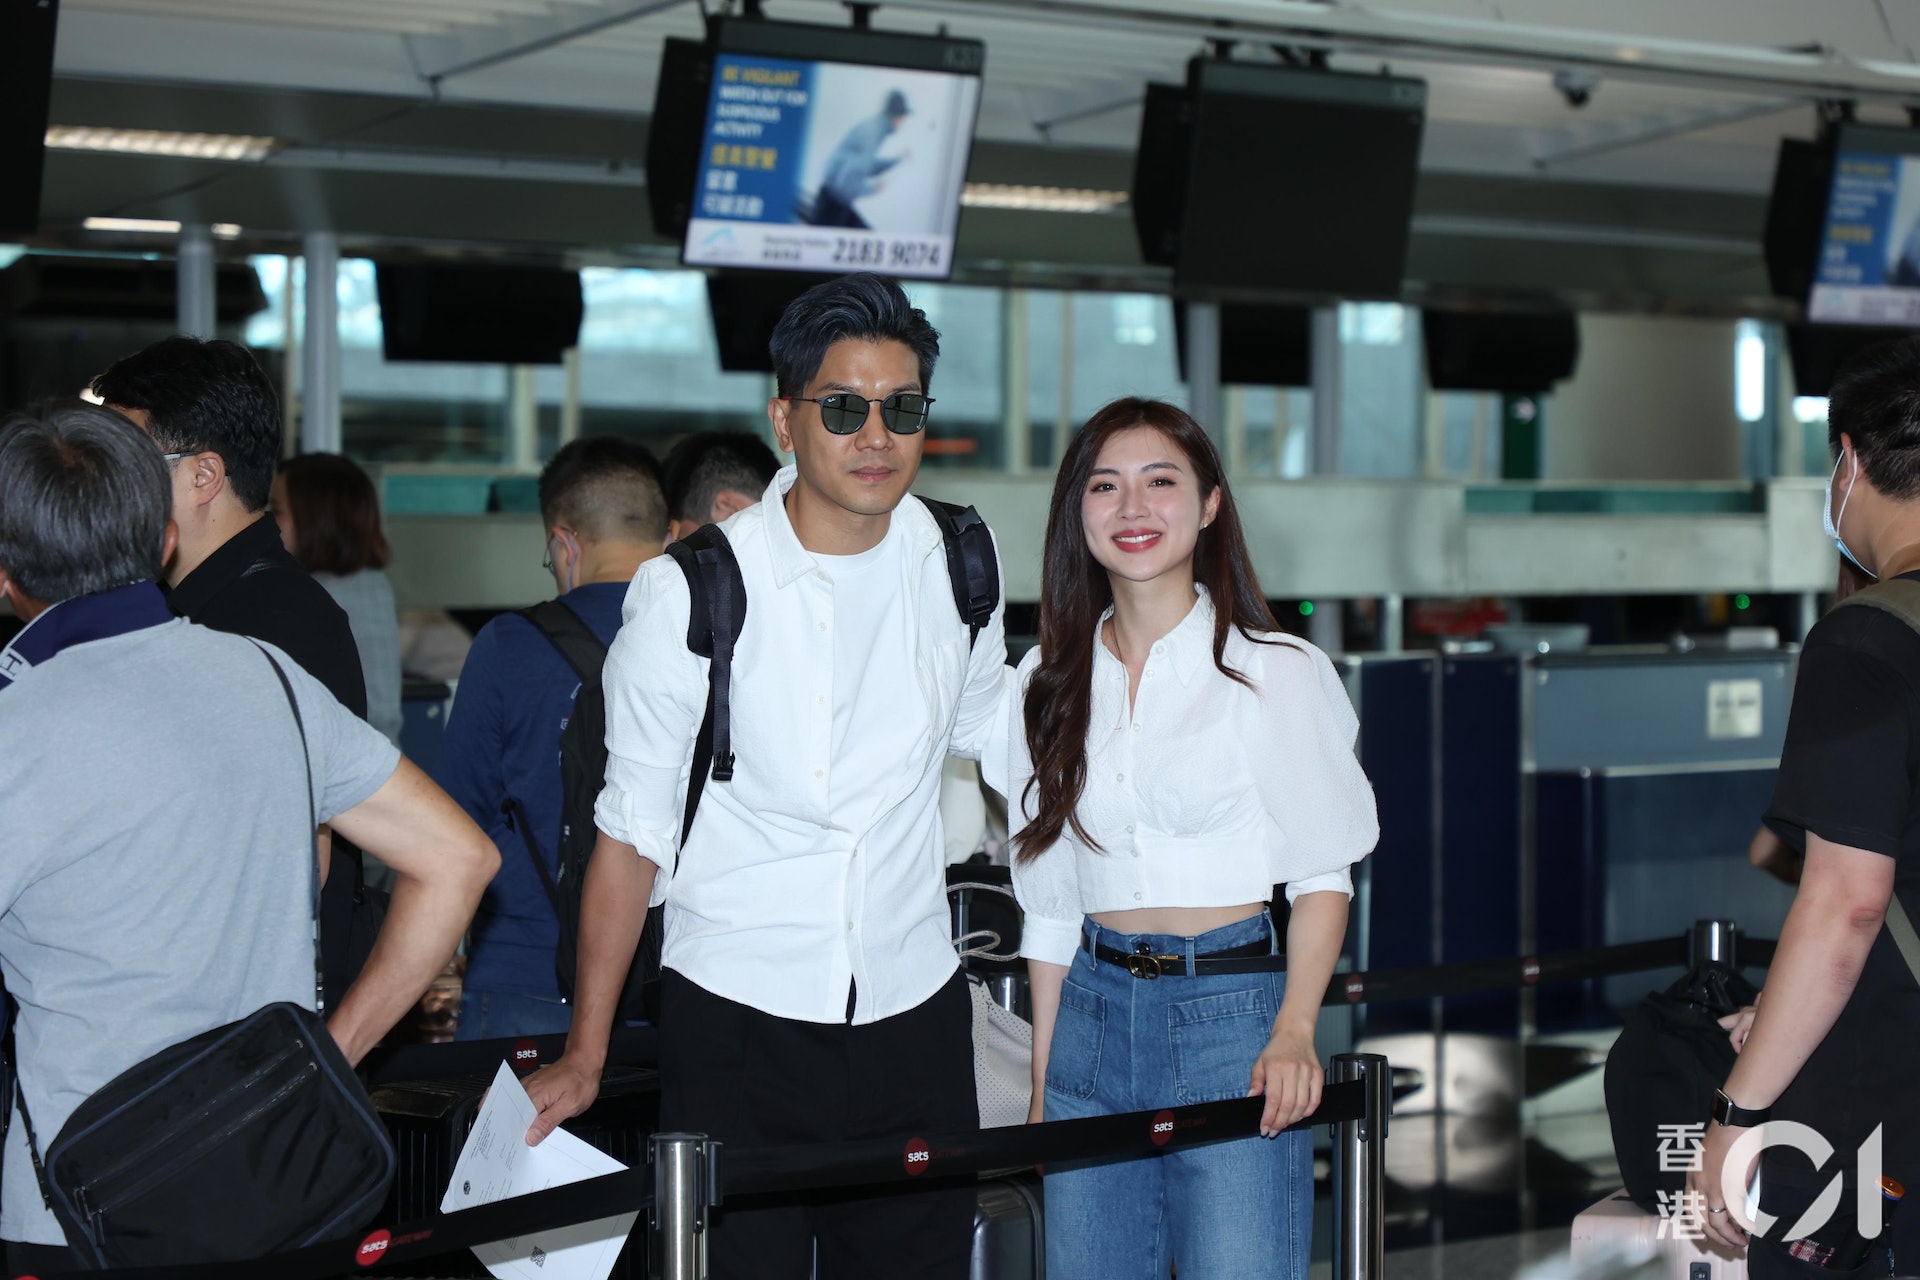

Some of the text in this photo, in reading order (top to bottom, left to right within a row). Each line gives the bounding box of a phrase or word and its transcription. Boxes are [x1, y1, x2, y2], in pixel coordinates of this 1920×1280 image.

[516, 1049, 538, 1059] sats
[1153, 1120, 1174, 1133] sats
[907, 1150, 929, 1163] sats
[361, 1239, 388, 1254] sats
